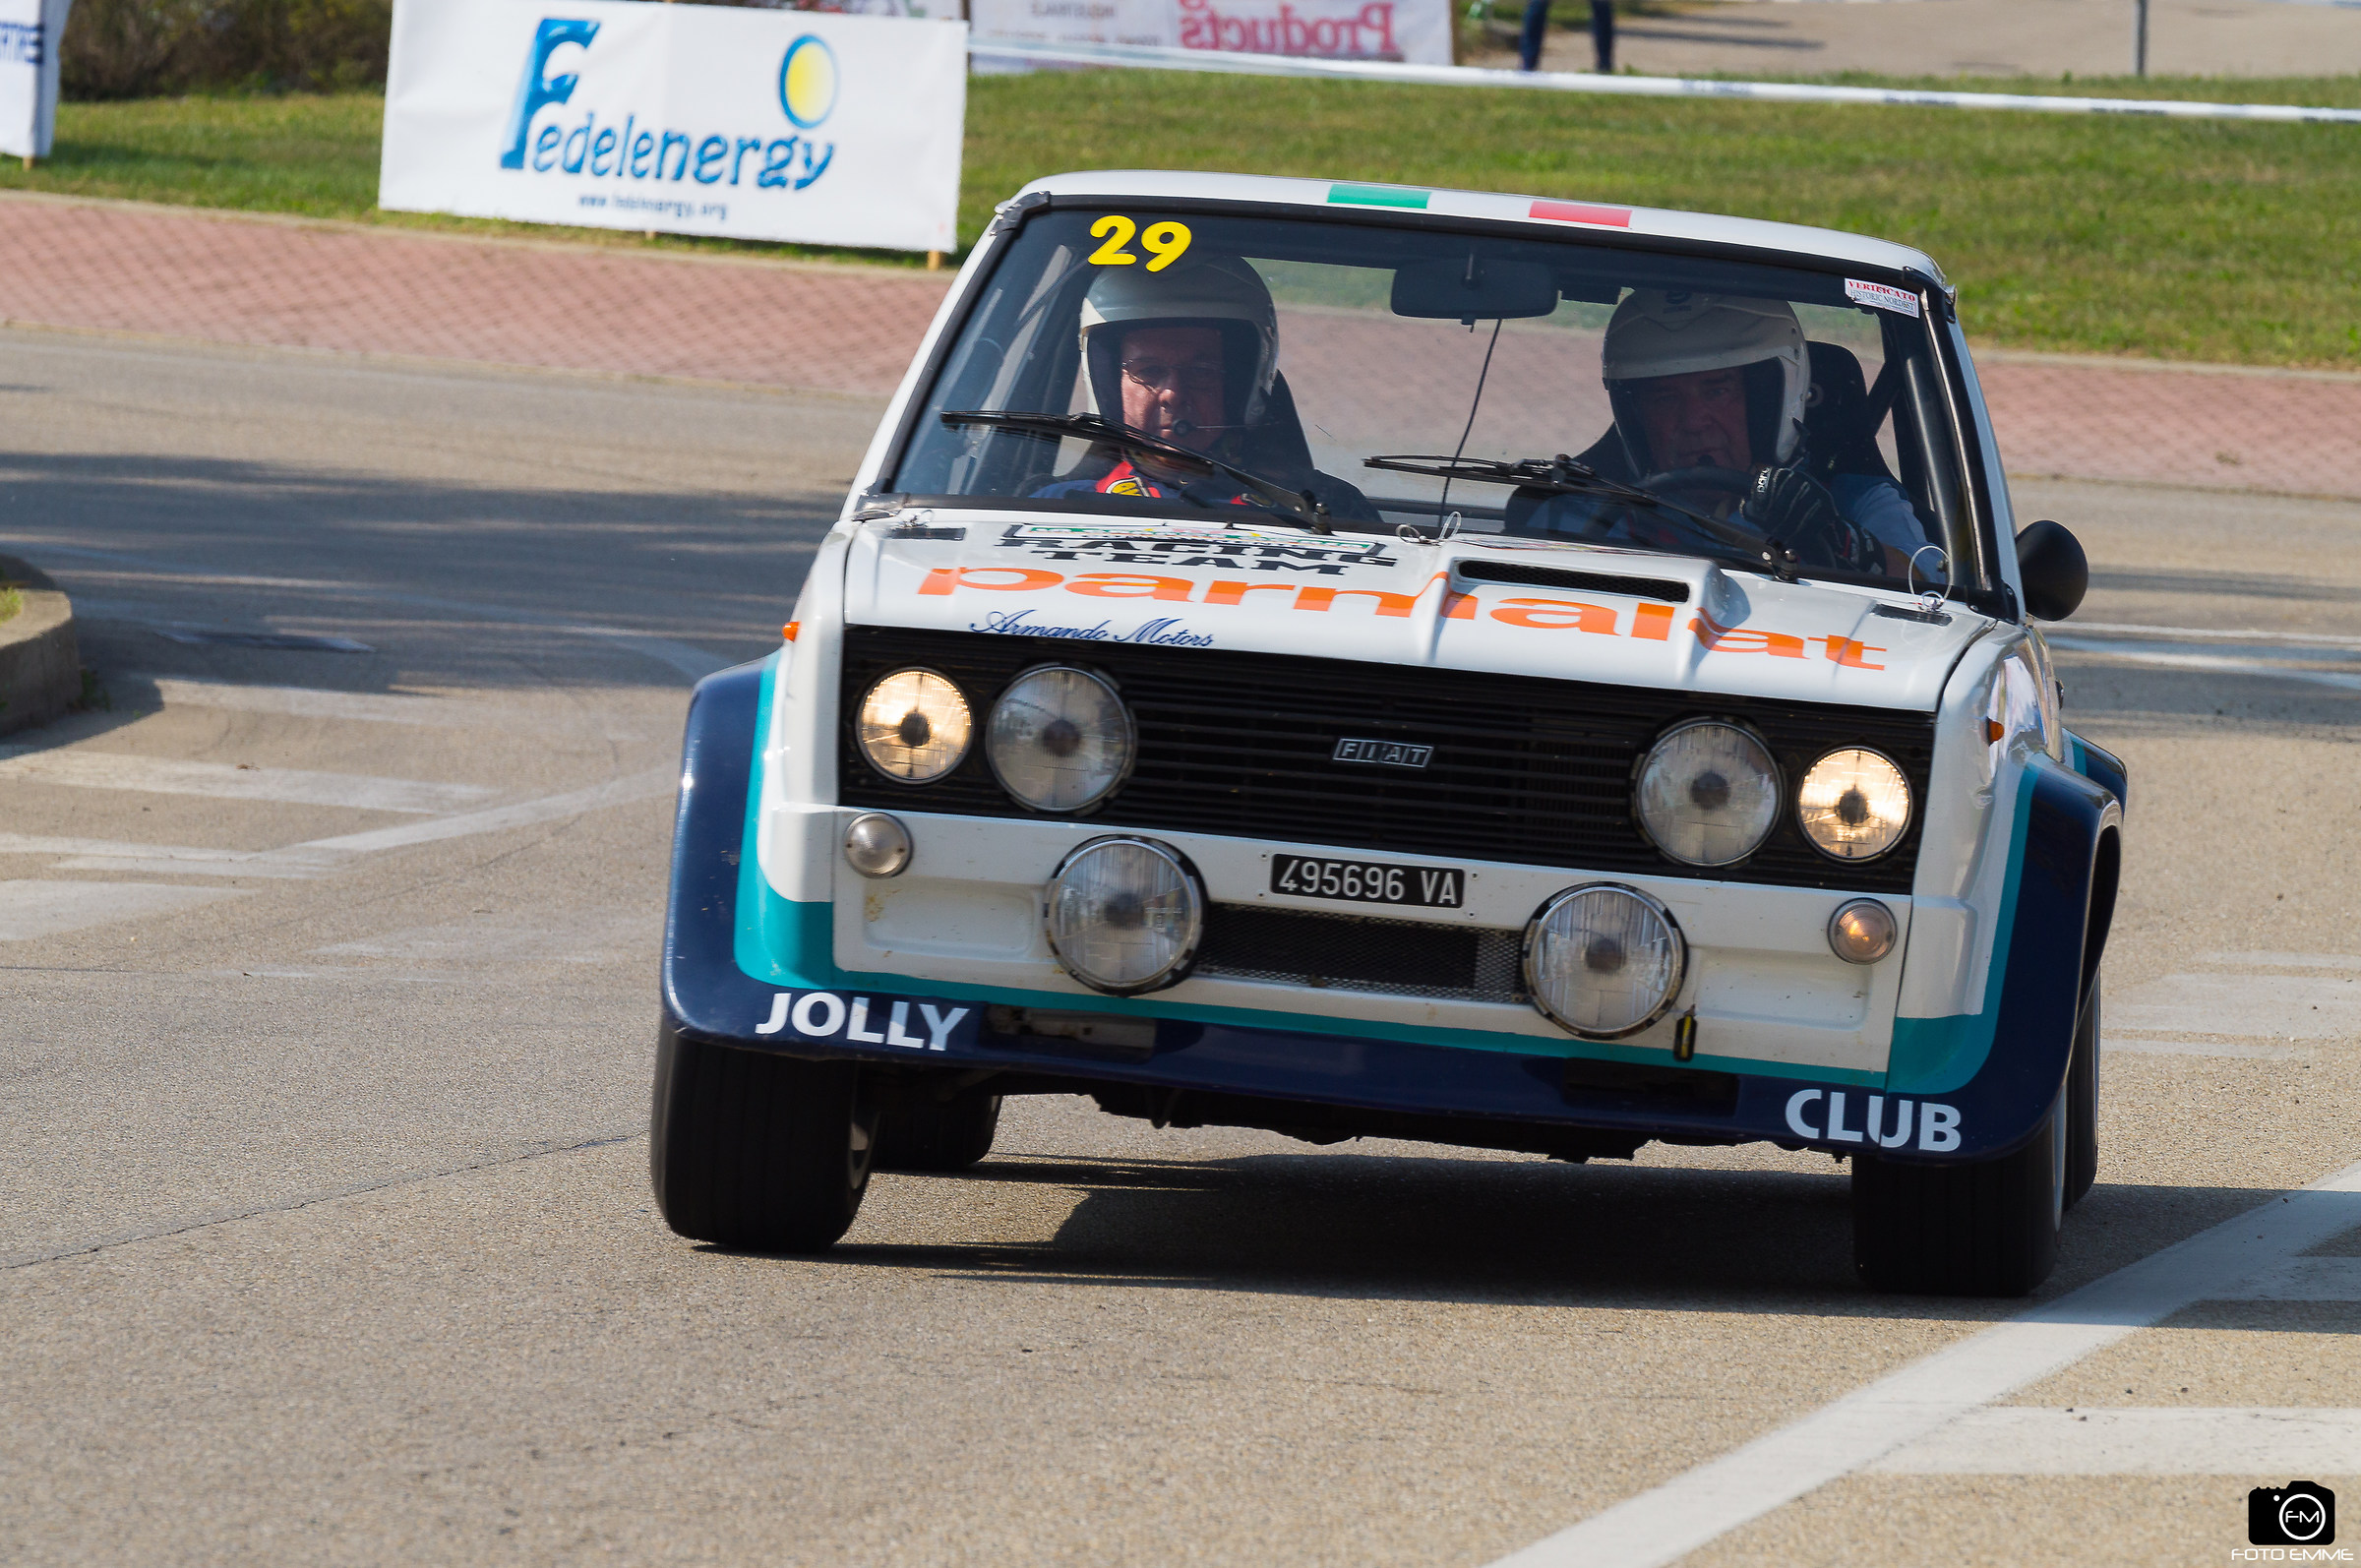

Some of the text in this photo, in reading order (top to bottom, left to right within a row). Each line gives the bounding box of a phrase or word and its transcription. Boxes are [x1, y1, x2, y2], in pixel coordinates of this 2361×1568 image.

[501, 18, 834, 190] Fedelenergy
[1088, 215, 1192, 271] 29
[1848, 280, 1915, 301] VERIFICATO
[1850, 289, 1883, 302] HISTORIC
[995, 538, 1397, 567] RACING
[1031, 549, 1348, 575] TEAM
[968, 609, 1216, 647] Armando Motors
[1341, 743, 1426, 763] FIAT
[1279, 859, 1458, 905] 495696 VA
[755, 992, 970, 1052] JOLLY
[1785, 1089, 1962, 1152] CLUB
